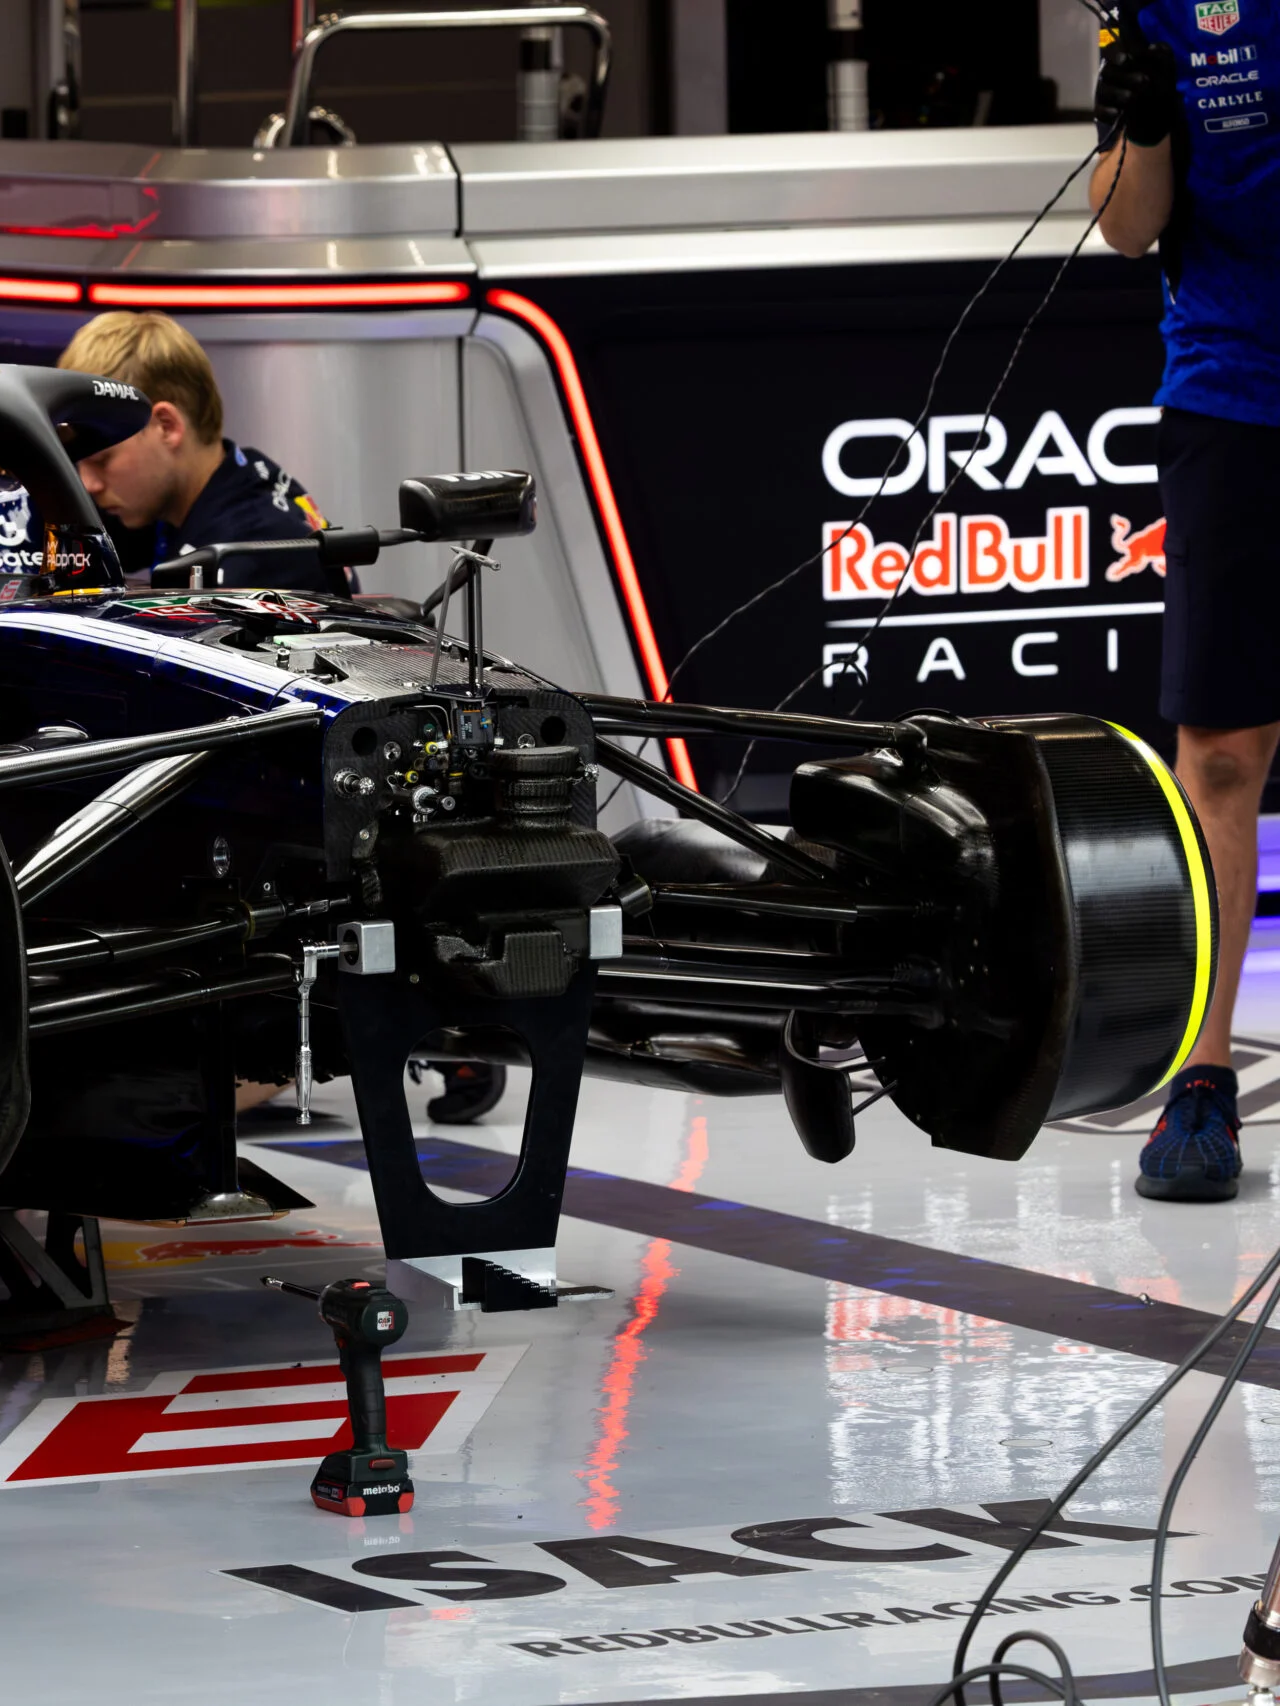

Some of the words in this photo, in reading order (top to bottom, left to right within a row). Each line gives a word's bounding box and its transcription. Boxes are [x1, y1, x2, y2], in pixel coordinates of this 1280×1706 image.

[1200, 2, 1235, 14] TAG
[1190, 48, 1238, 67] Mobil
[1195, 70, 1259, 87] ORACLE
[1198, 91, 1263, 109] CARLYLE
[92, 380, 139, 400] DAMAC
[822, 405, 1164, 497] ORAC
[822, 628, 1119, 688] RACI
[363, 1484, 400, 1496] metabo
[220, 1498, 1201, 1613] ISACK
